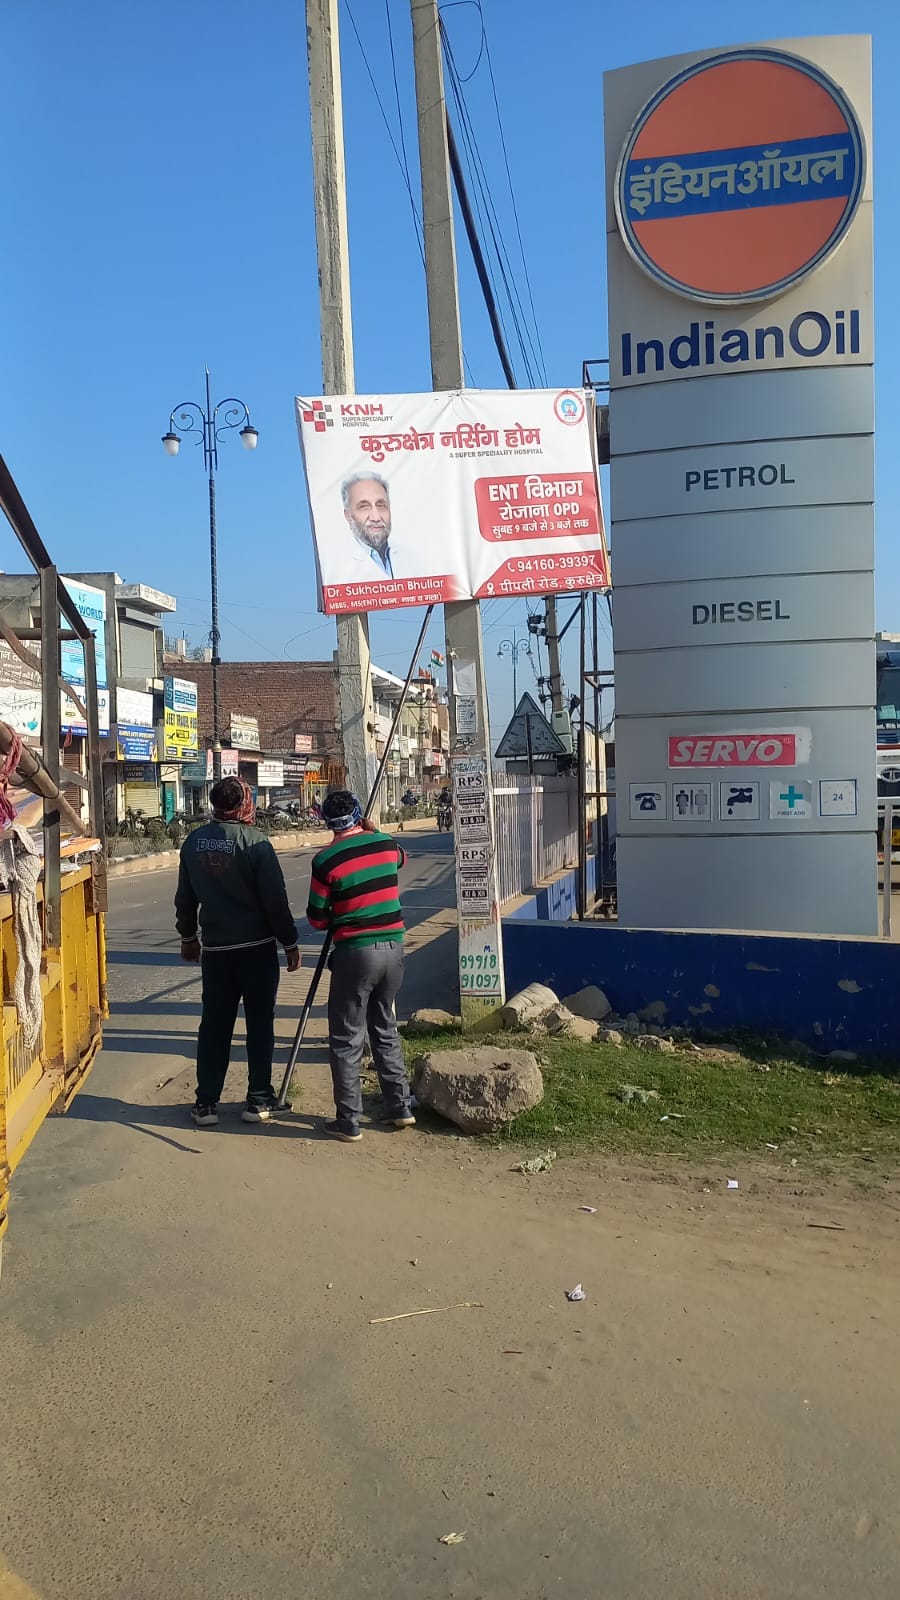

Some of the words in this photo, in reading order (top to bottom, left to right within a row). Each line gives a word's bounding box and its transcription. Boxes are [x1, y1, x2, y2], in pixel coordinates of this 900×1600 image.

[630, 148, 849, 215] इंडियनऑयल
[621, 309, 860, 376] IndianOil
[340, 403, 384, 416] KNH
[359, 426, 435, 463] कुरुक्षेत्र
[439, 422, 499, 449] नर्सिंग
[504, 421, 541, 448] होम
[455, 451, 476, 459] SUPER
[477, 449, 513, 458] SPECIALITY
[514, 447, 544, 456] HOSPITAL
[685, 463, 796, 492] PETROL
[488, 483, 519, 502] ENT
[524, 475, 584, 500] विभाग
[498, 502, 550, 521] रोजाना
[553, 502, 580, 517] OPD
[491, 524, 513, 539] सुबह
[514, 523, 520, 534] 9
[521, 520, 538, 533] बजे
[538, 519, 548, 532] से
[556, 517, 571, 530] बजे
[573, 518, 590, 529] तक
[517, 555, 596, 573] 94160-39397
[327, 587, 343, 598] Dr.
[345, 581, 404, 597] Sukhchain
[407, 578, 445, 591] Bhullar
[499, 576, 535, 593] पीपली
[563, 571, 604, 590] कुरुक्षेत्र
[79, 604, 104, 620] WORLD
[692, 599, 791, 626] DIESEL
[673, 738, 784, 763] SERVO
[458, 775, 483, 787] RPS
[832, 792, 844, 802] 24
[462, 850, 486, 860] RPS
[461, 973, 499, 990] 91097
